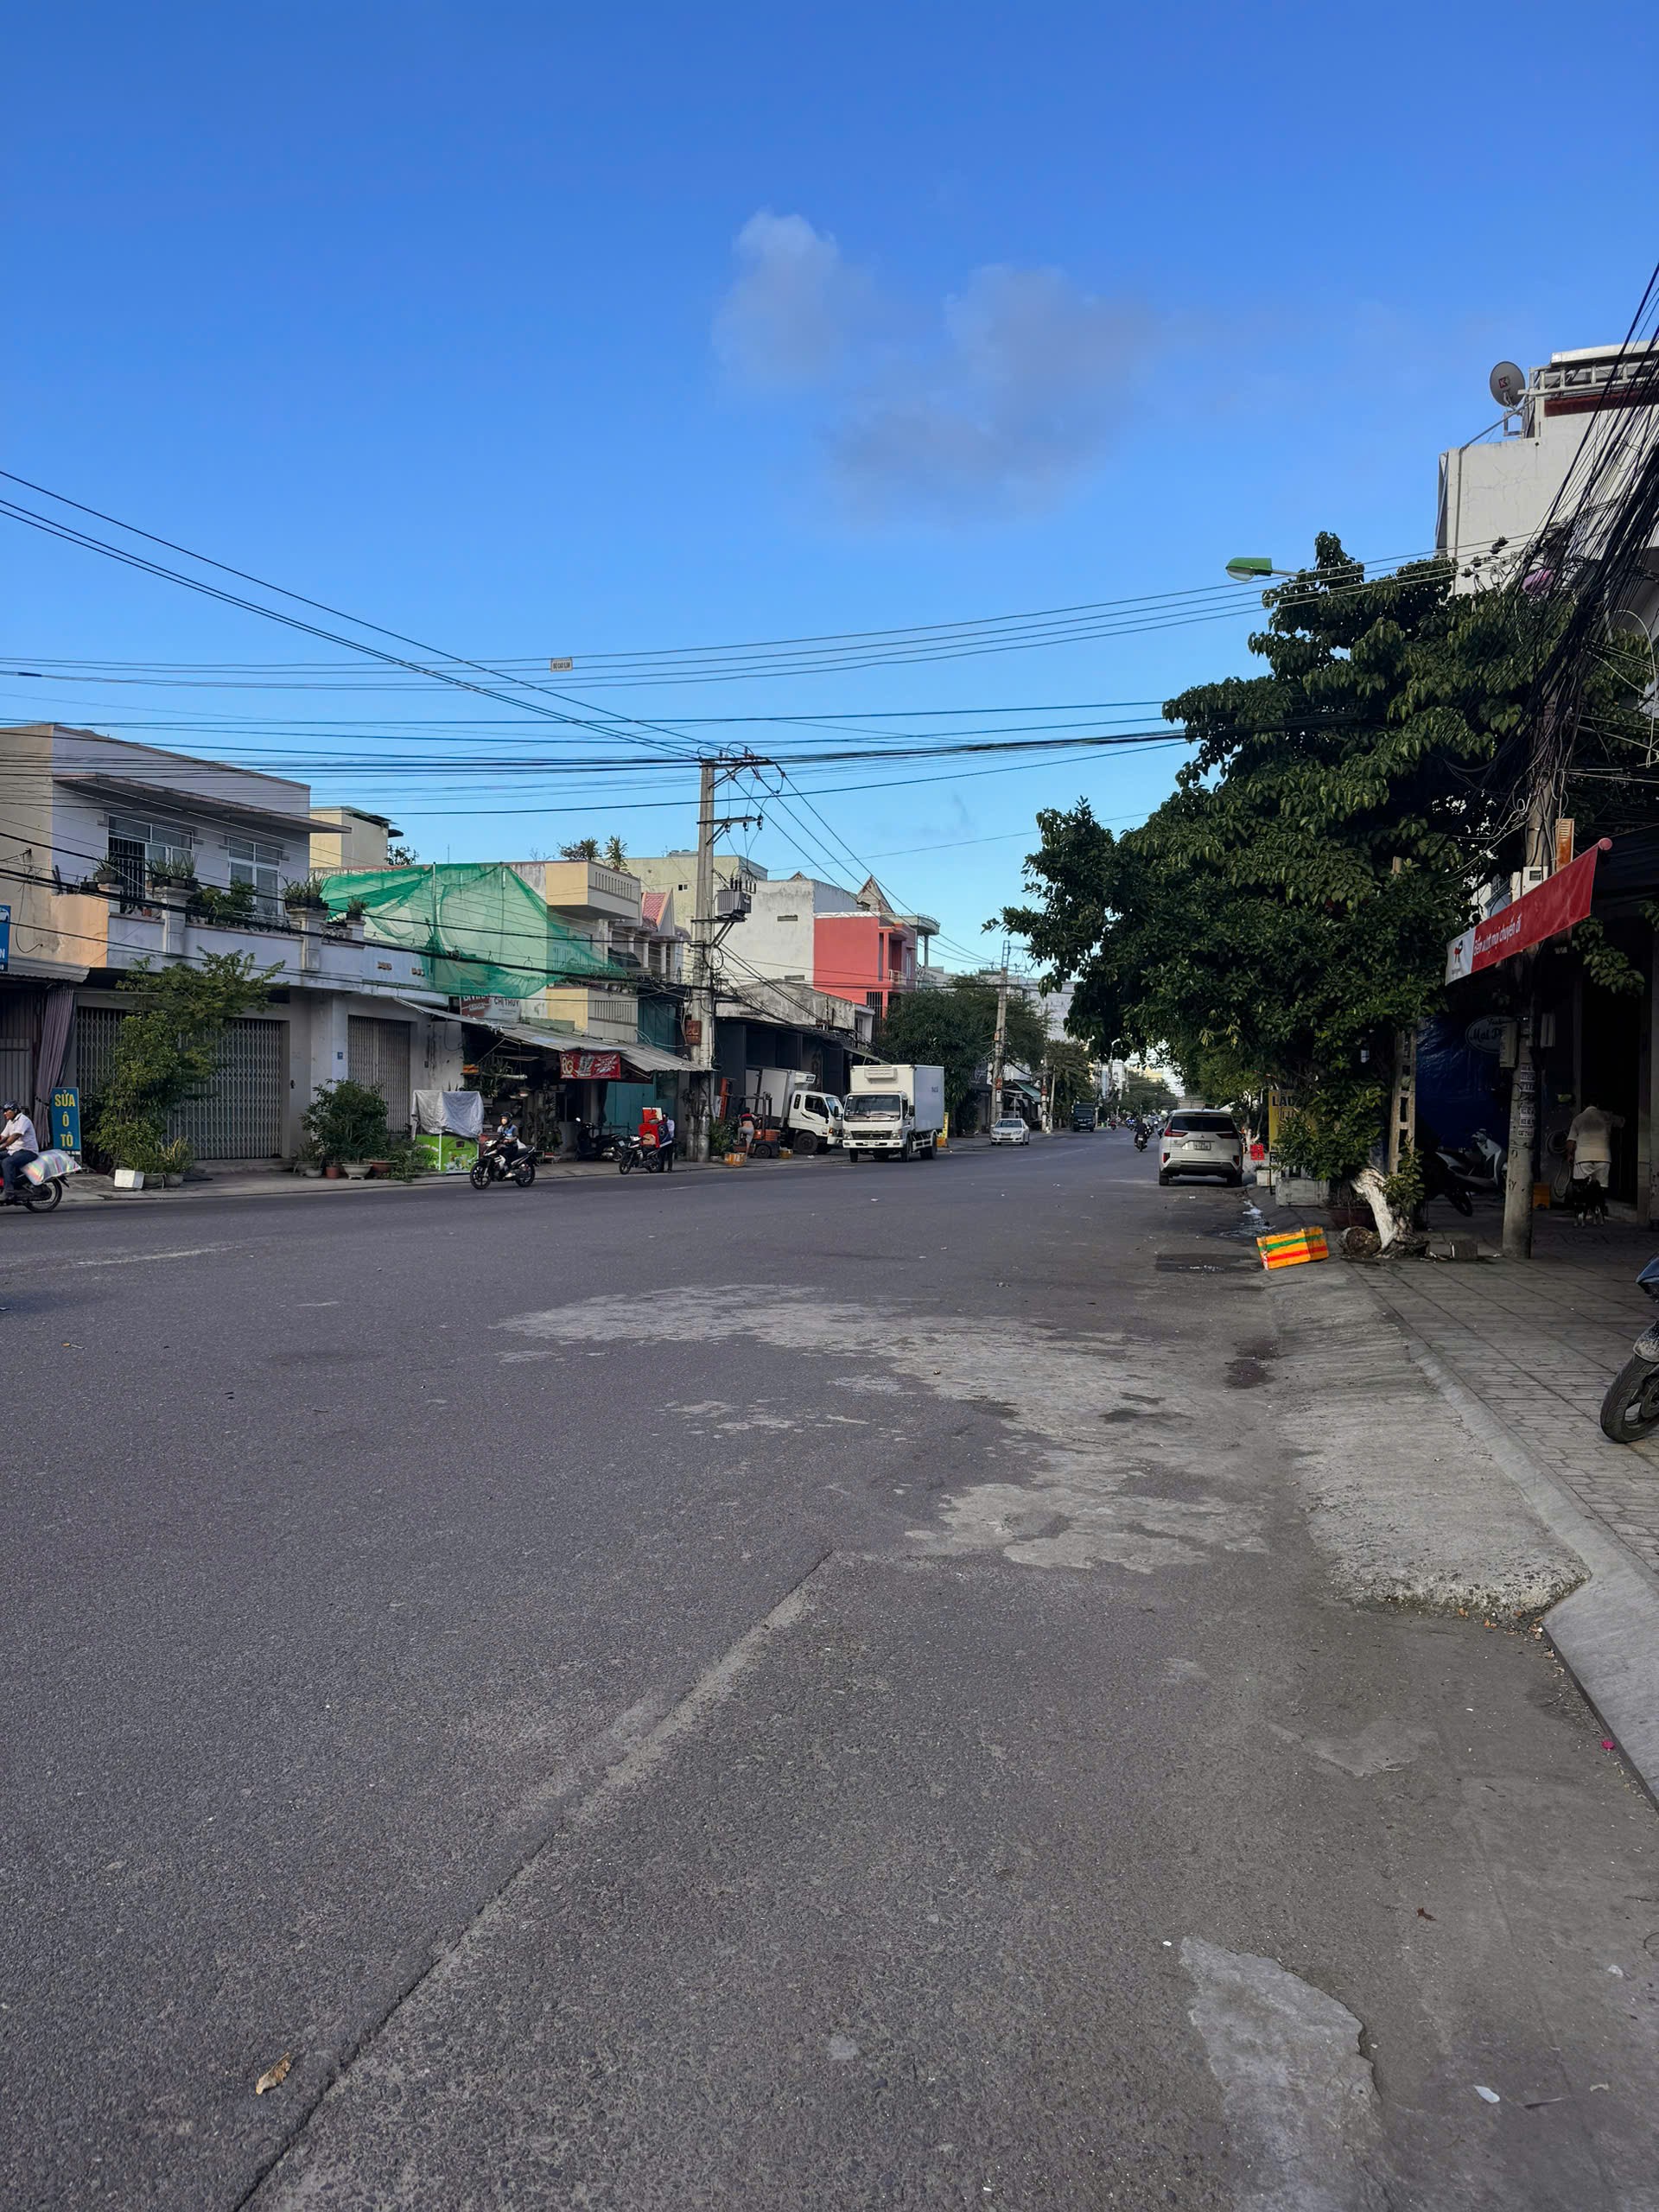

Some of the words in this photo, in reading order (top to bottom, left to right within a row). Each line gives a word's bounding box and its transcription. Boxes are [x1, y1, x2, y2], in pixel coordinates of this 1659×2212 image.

[54, 1090, 75, 1107] SỬA
[62, 1111, 69, 1128] Ô
[60, 1131, 73, 1147] TÔ
